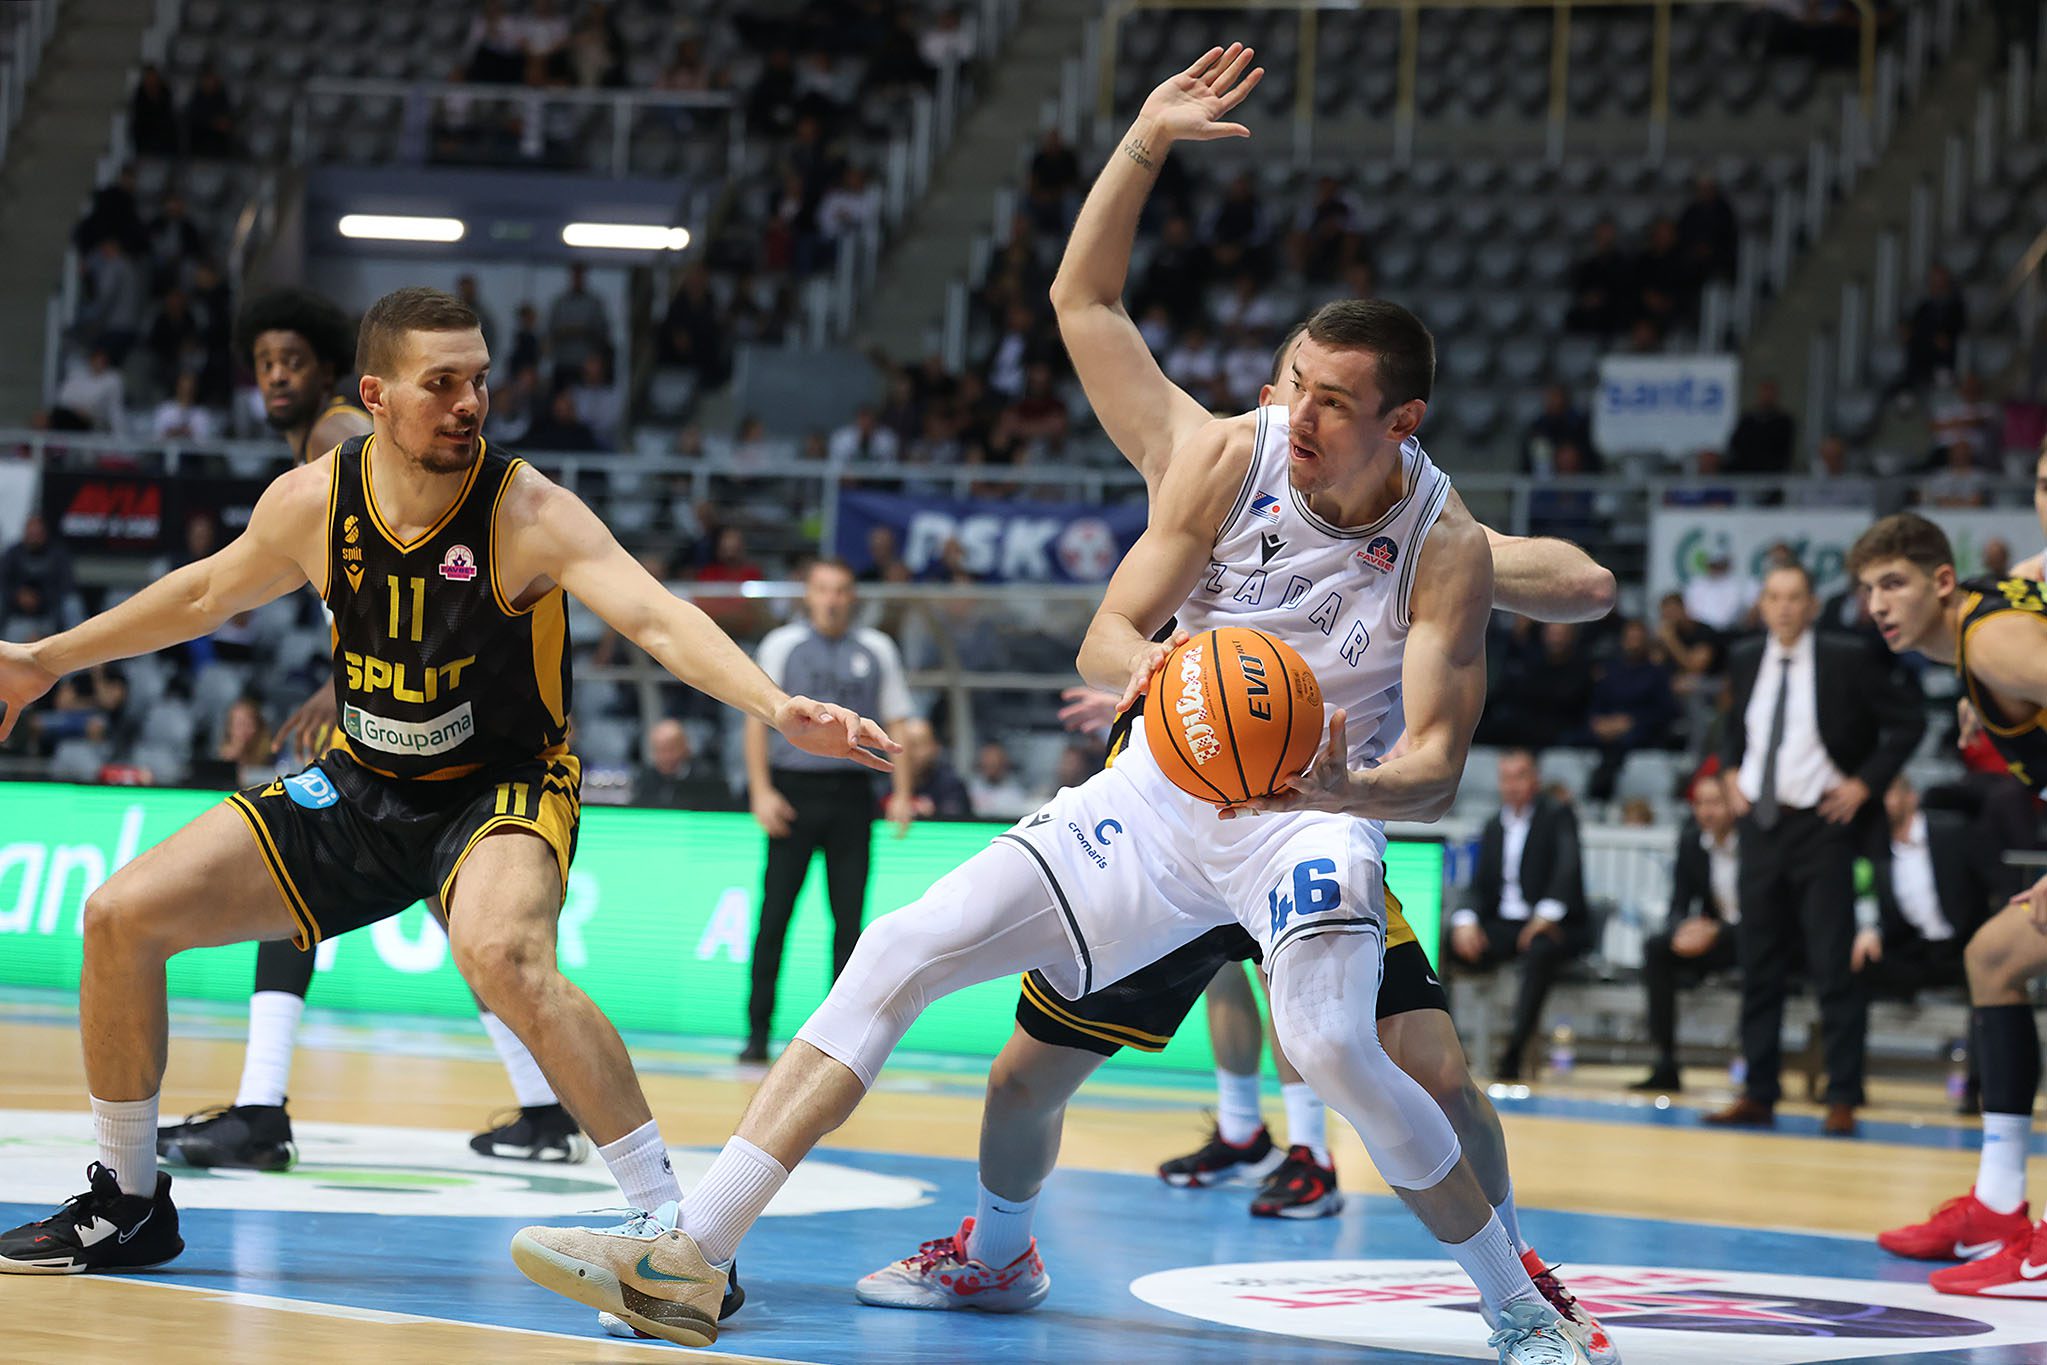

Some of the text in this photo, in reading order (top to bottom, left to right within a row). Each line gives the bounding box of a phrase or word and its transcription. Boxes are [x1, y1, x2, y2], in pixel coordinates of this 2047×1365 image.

[387, 574, 425, 642] 11
[1205, 562, 1371, 668] ZADAR
[344, 651, 477, 704] SPLIT
[1176, 645, 1222, 766] Wilson
[1238, 655, 1272, 722] EVO
[364, 714, 472, 751] Groupama
[494, 782, 530, 816] 11
[1068, 822, 1108, 869] cromaris
[1267, 857, 1341, 944] 46
